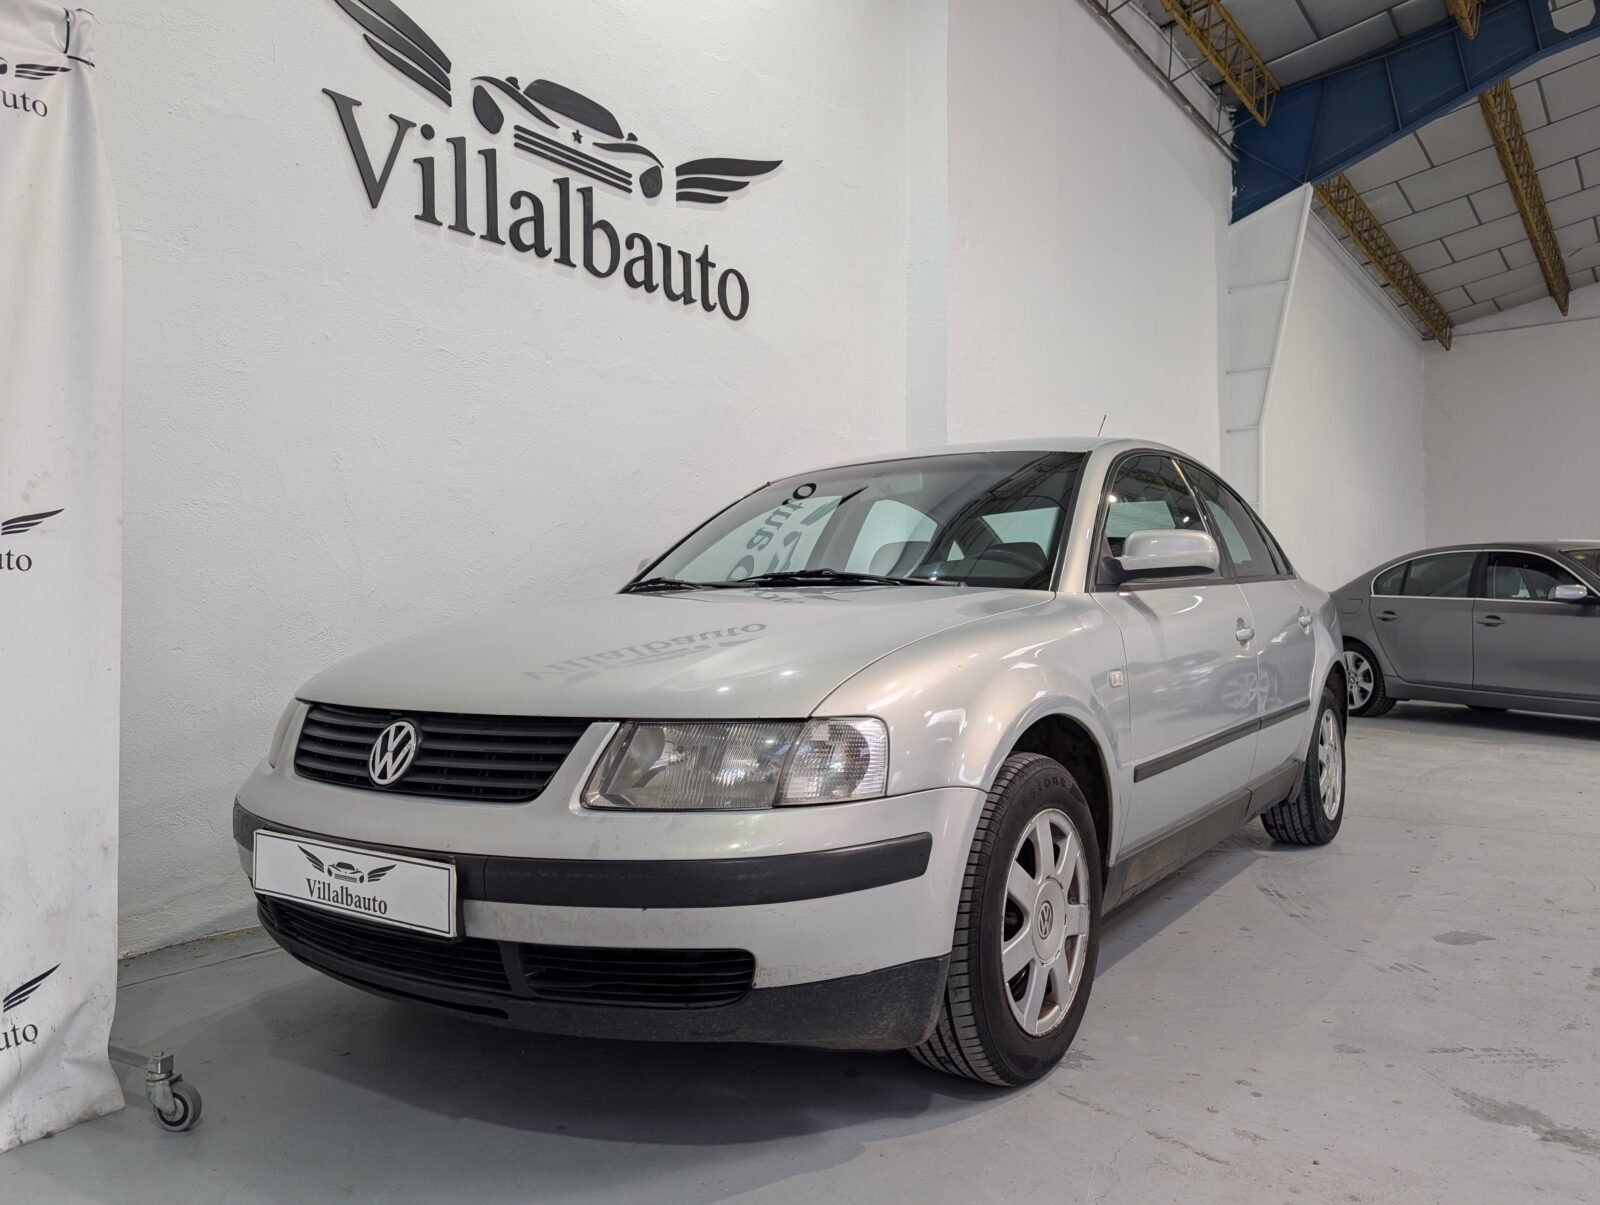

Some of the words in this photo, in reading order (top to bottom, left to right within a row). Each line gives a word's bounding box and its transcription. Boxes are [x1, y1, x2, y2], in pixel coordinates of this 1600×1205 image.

[322, 87, 750, 321] Villalbauto
[0, 549, 33, 572] to
[369, 721, 417, 785] VW
[306, 877, 388, 915] Villalbauto
